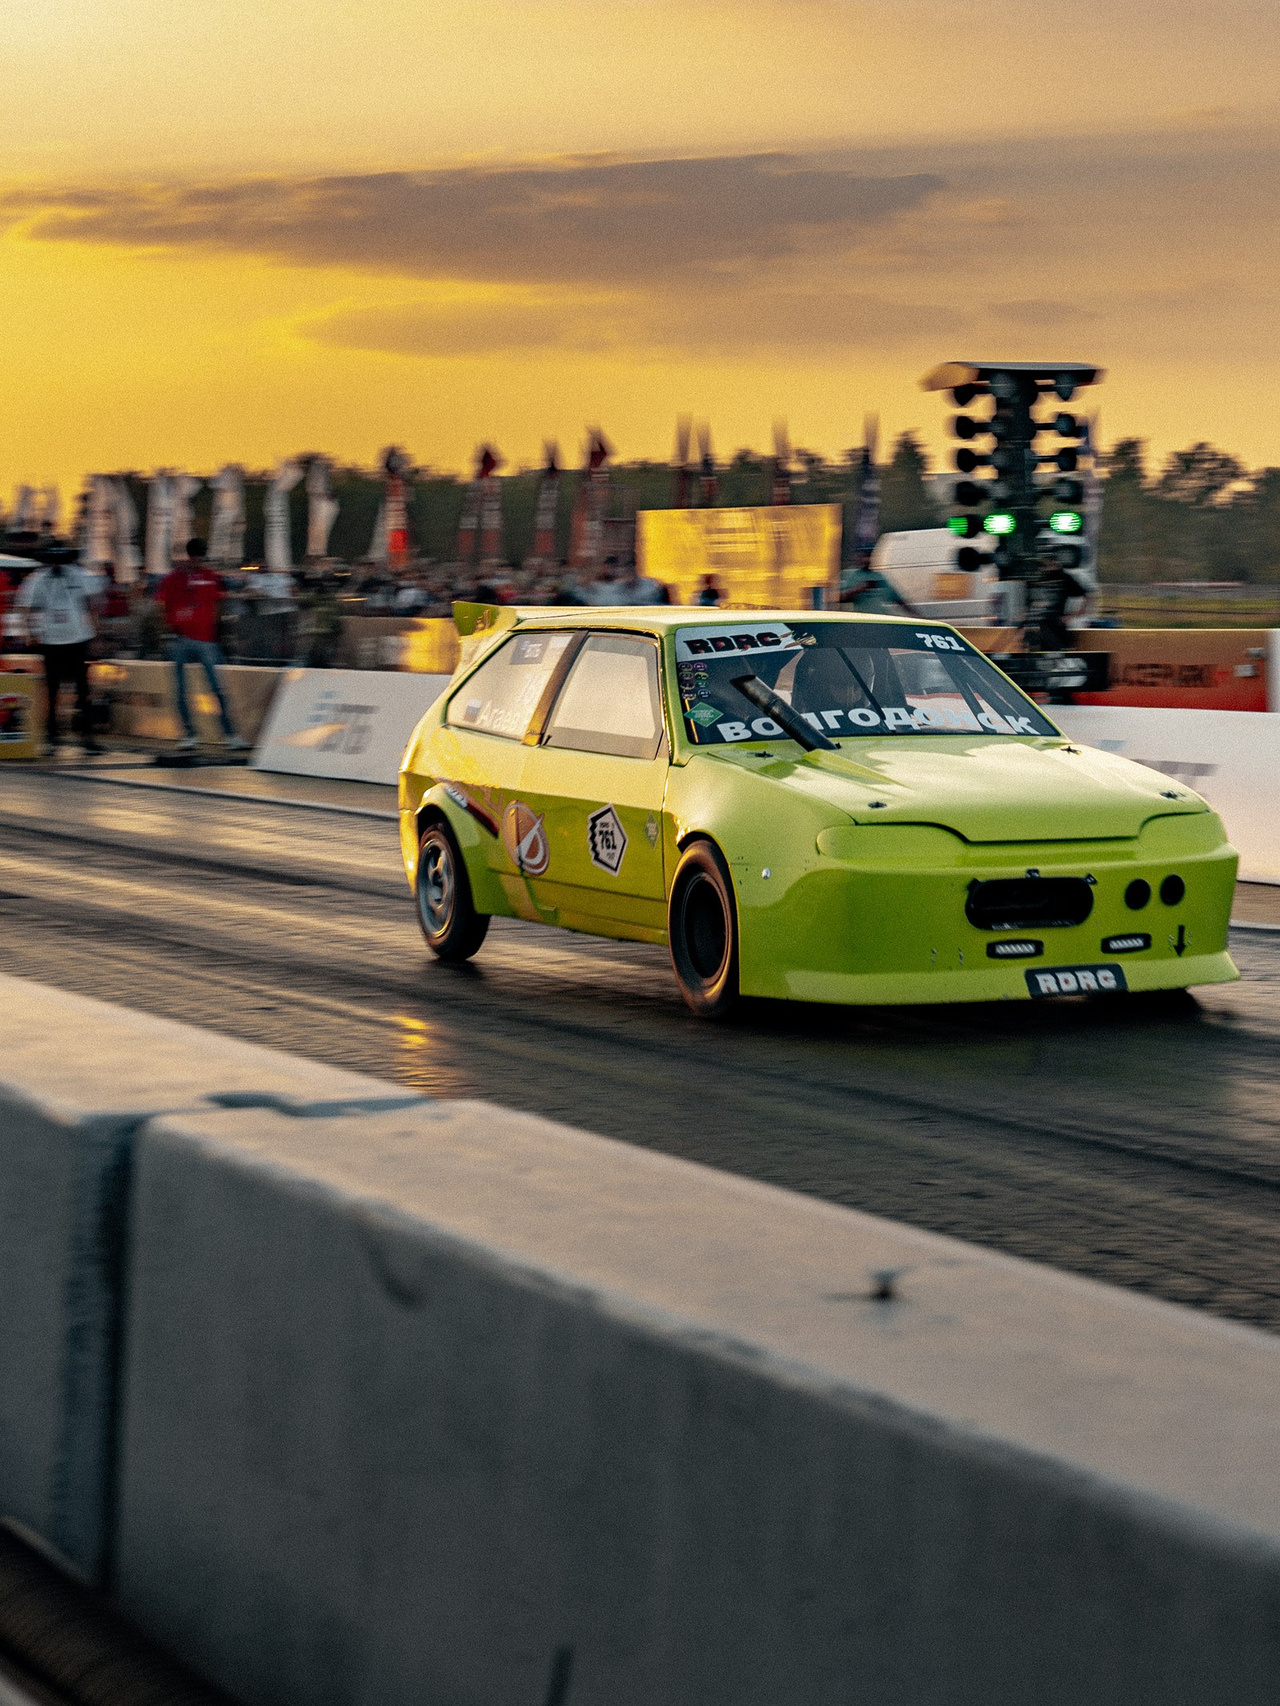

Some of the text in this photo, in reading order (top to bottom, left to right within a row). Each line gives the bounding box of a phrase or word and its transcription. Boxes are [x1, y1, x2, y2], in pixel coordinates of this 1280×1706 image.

[683, 631, 783, 655] RDRC
[915, 632, 966, 652] 761
[1035, 969, 1118, 995] RDRC
